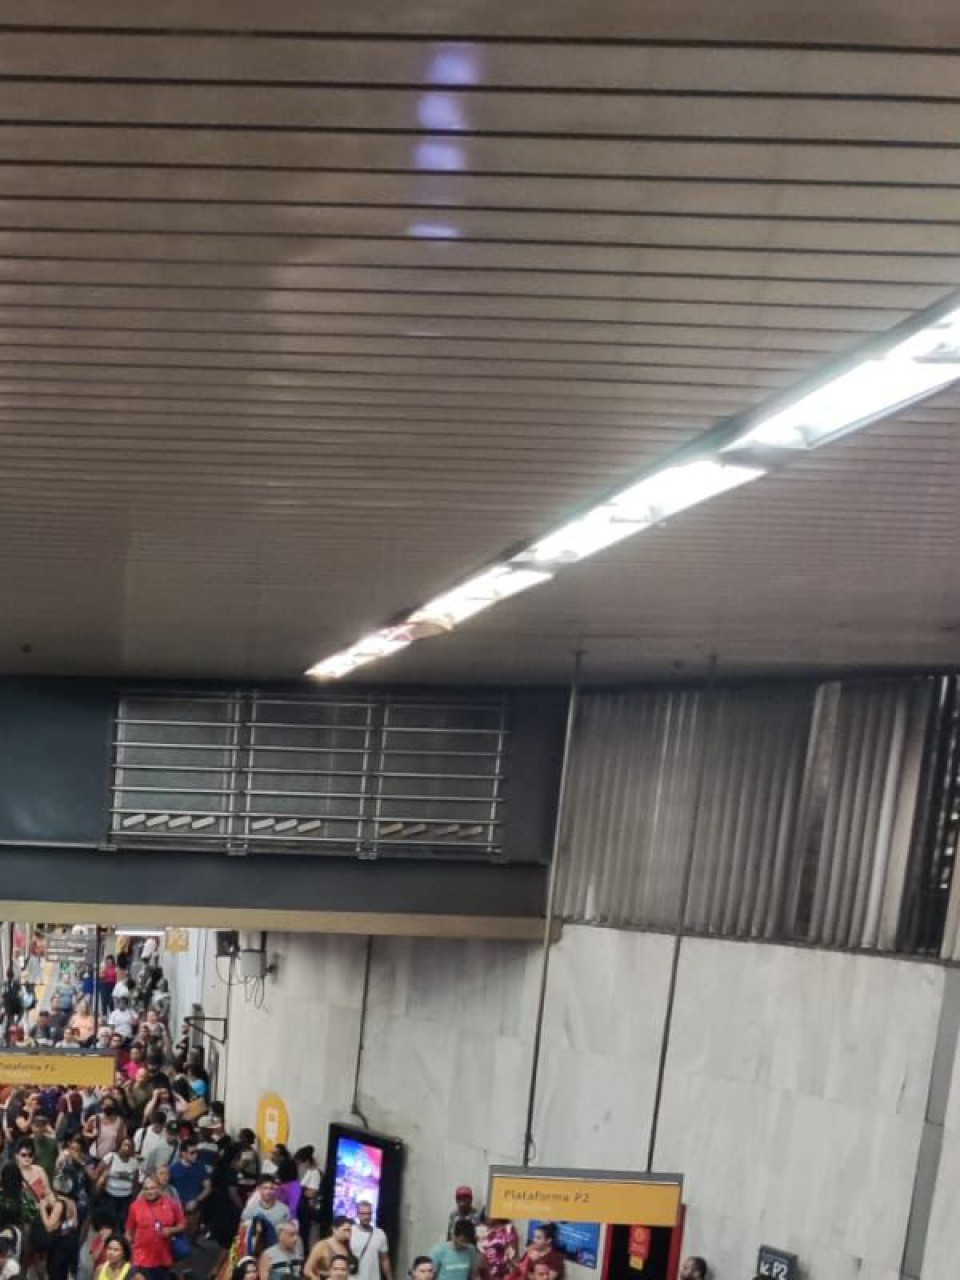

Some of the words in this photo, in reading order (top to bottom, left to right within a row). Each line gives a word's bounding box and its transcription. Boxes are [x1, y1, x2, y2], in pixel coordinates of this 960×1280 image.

[503, 1188, 569, 1203] Plataforma
[573, 1191, 590, 1204] P2
[772, 1260, 788, 1280] P2
